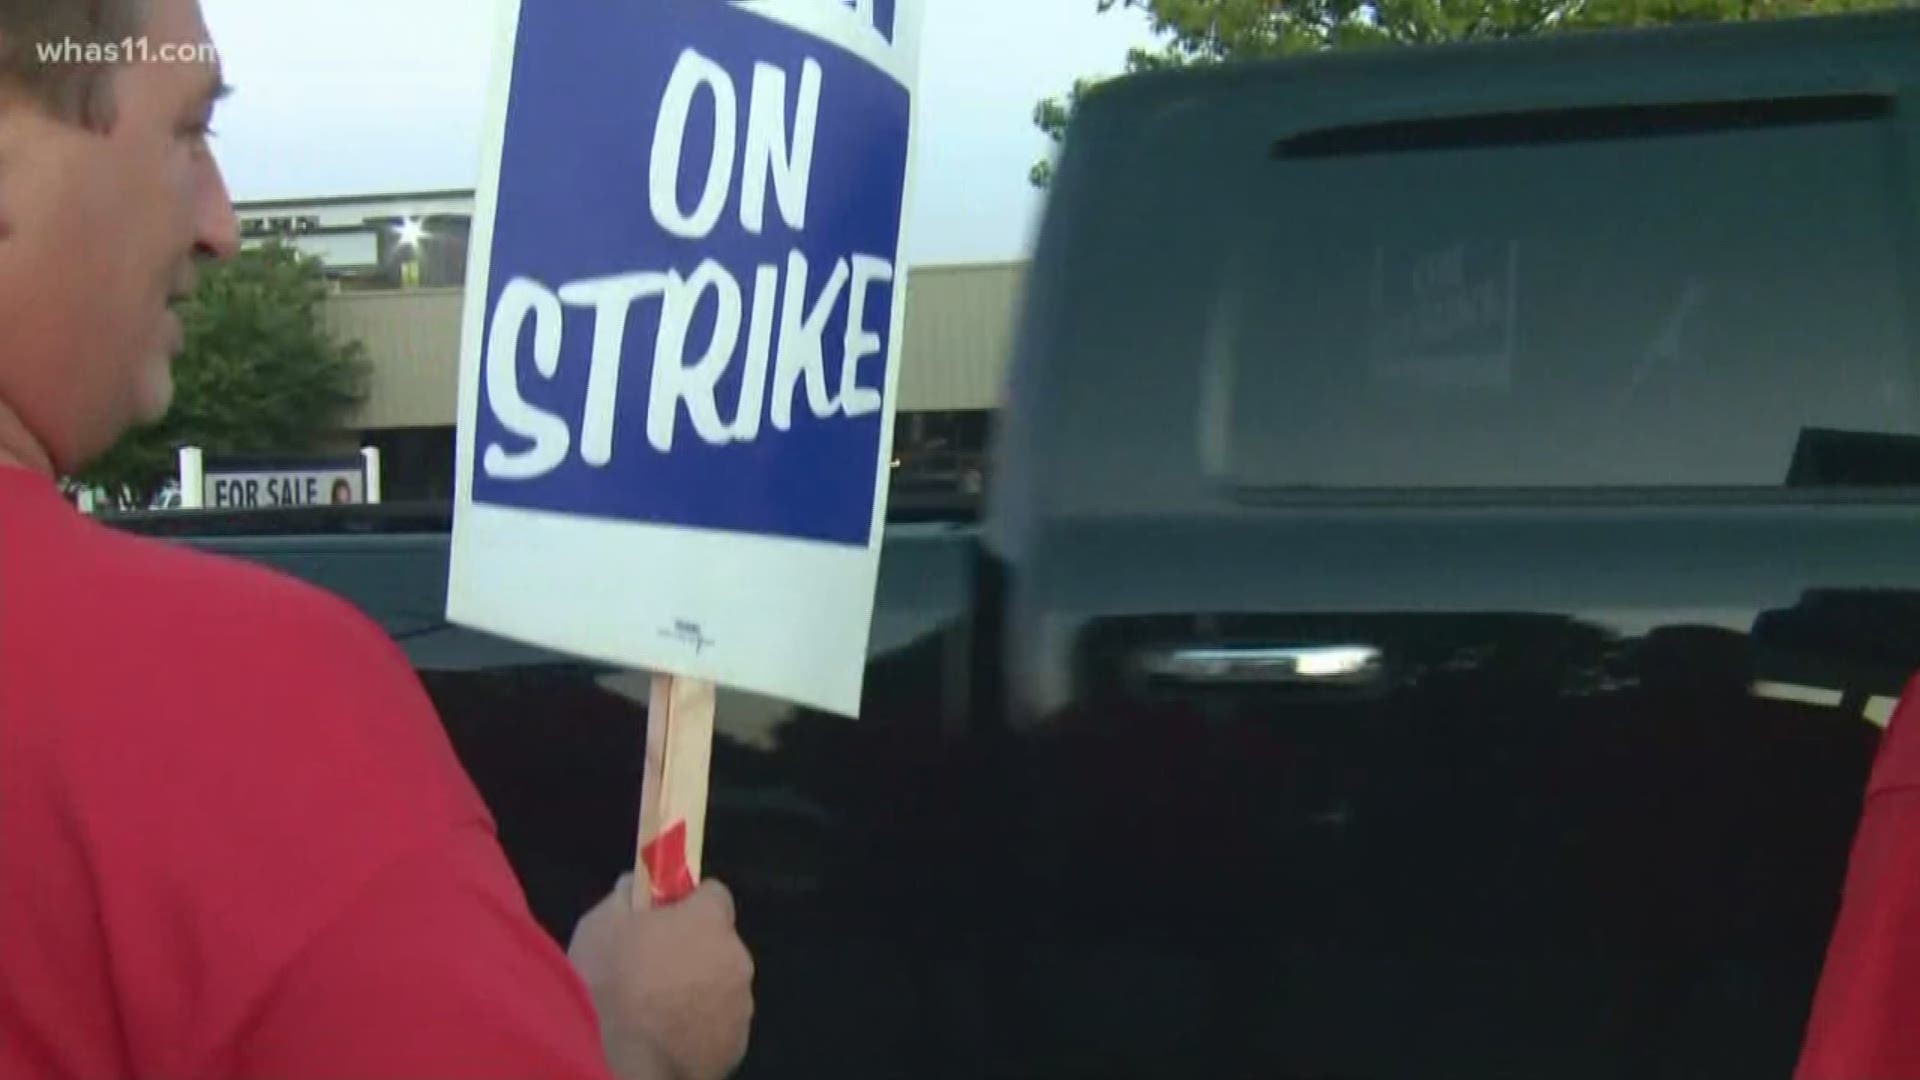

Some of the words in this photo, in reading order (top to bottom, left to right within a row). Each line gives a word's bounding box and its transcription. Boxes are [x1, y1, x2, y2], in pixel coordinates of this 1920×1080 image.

[649, 47, 822, 239] ON
[483, 248, 894, 478] STRIKE
[215, 479, 258, 507] FOR
[267, 477, 318, 505] SALE
